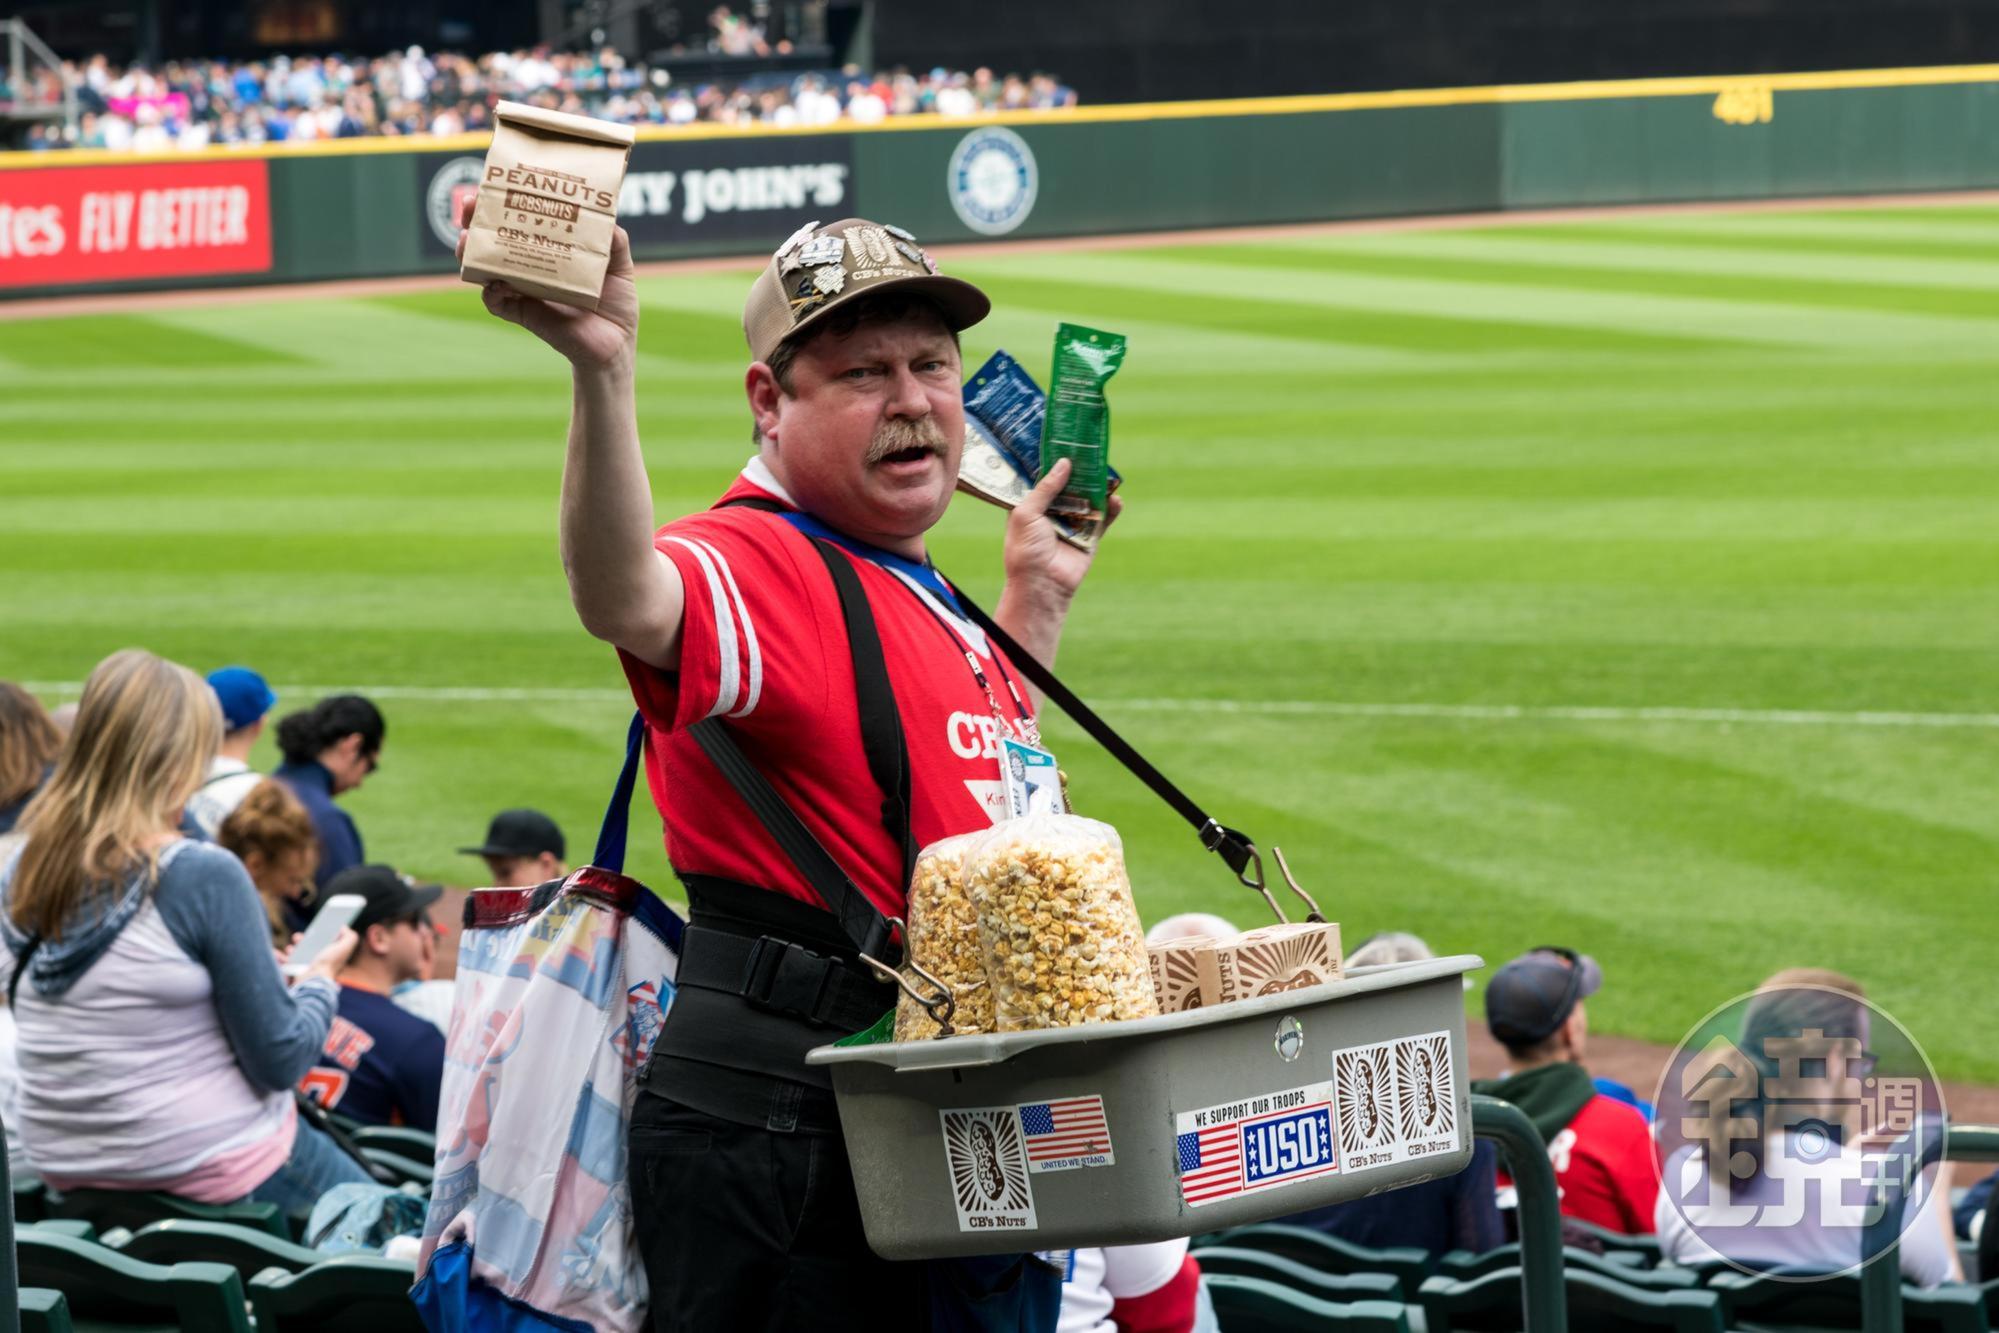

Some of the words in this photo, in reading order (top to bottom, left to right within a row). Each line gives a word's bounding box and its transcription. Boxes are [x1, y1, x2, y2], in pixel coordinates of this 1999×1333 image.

[487, 166, 614, 208] PEANUTS
[683, 163, 848, 224] JOHN'S
[79, 191, 135, 254] FLY
[138, 185, 249, 250] BETTER
[510, 192, 574, 219] #CBSNUTS
[1195, 1112, 1207, 1127] WE
[1211, 1103, 1249, 1124] SUPPORT
[1252, 1099, 1269, 1115] OUR
[1273, 1090, 1305, 1110] TROOPS
[1257, 1116, 1319, 1175] USO
[1408, 1144, 1427, 1156] CB's
[1041, 1160, 1068, 1170] UNITED
[1068, 1158, 1080, 1167] WE
[1081, 1156, 1105, 1165] STAND
[1349, 1156, 1368, 1169] CB's
[969, 1216, 994, 1228] CB's
